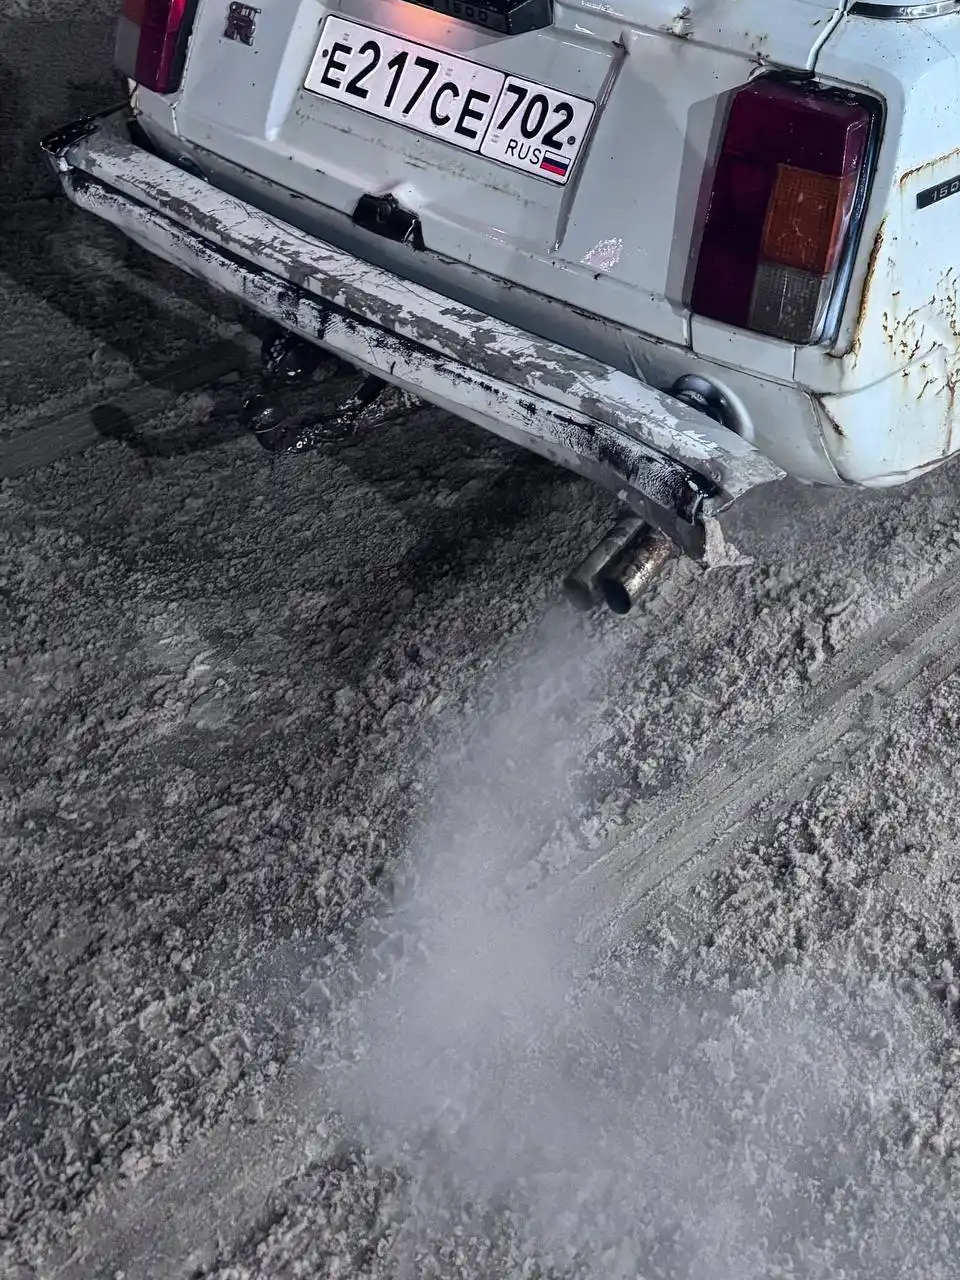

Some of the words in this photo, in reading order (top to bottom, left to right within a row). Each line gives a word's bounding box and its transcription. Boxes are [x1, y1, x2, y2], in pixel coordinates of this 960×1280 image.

[320, 40, 490, 139] Е217СЕ
[497, 84, 574, 150] 702
[505, 139, 540, 165] RUS
